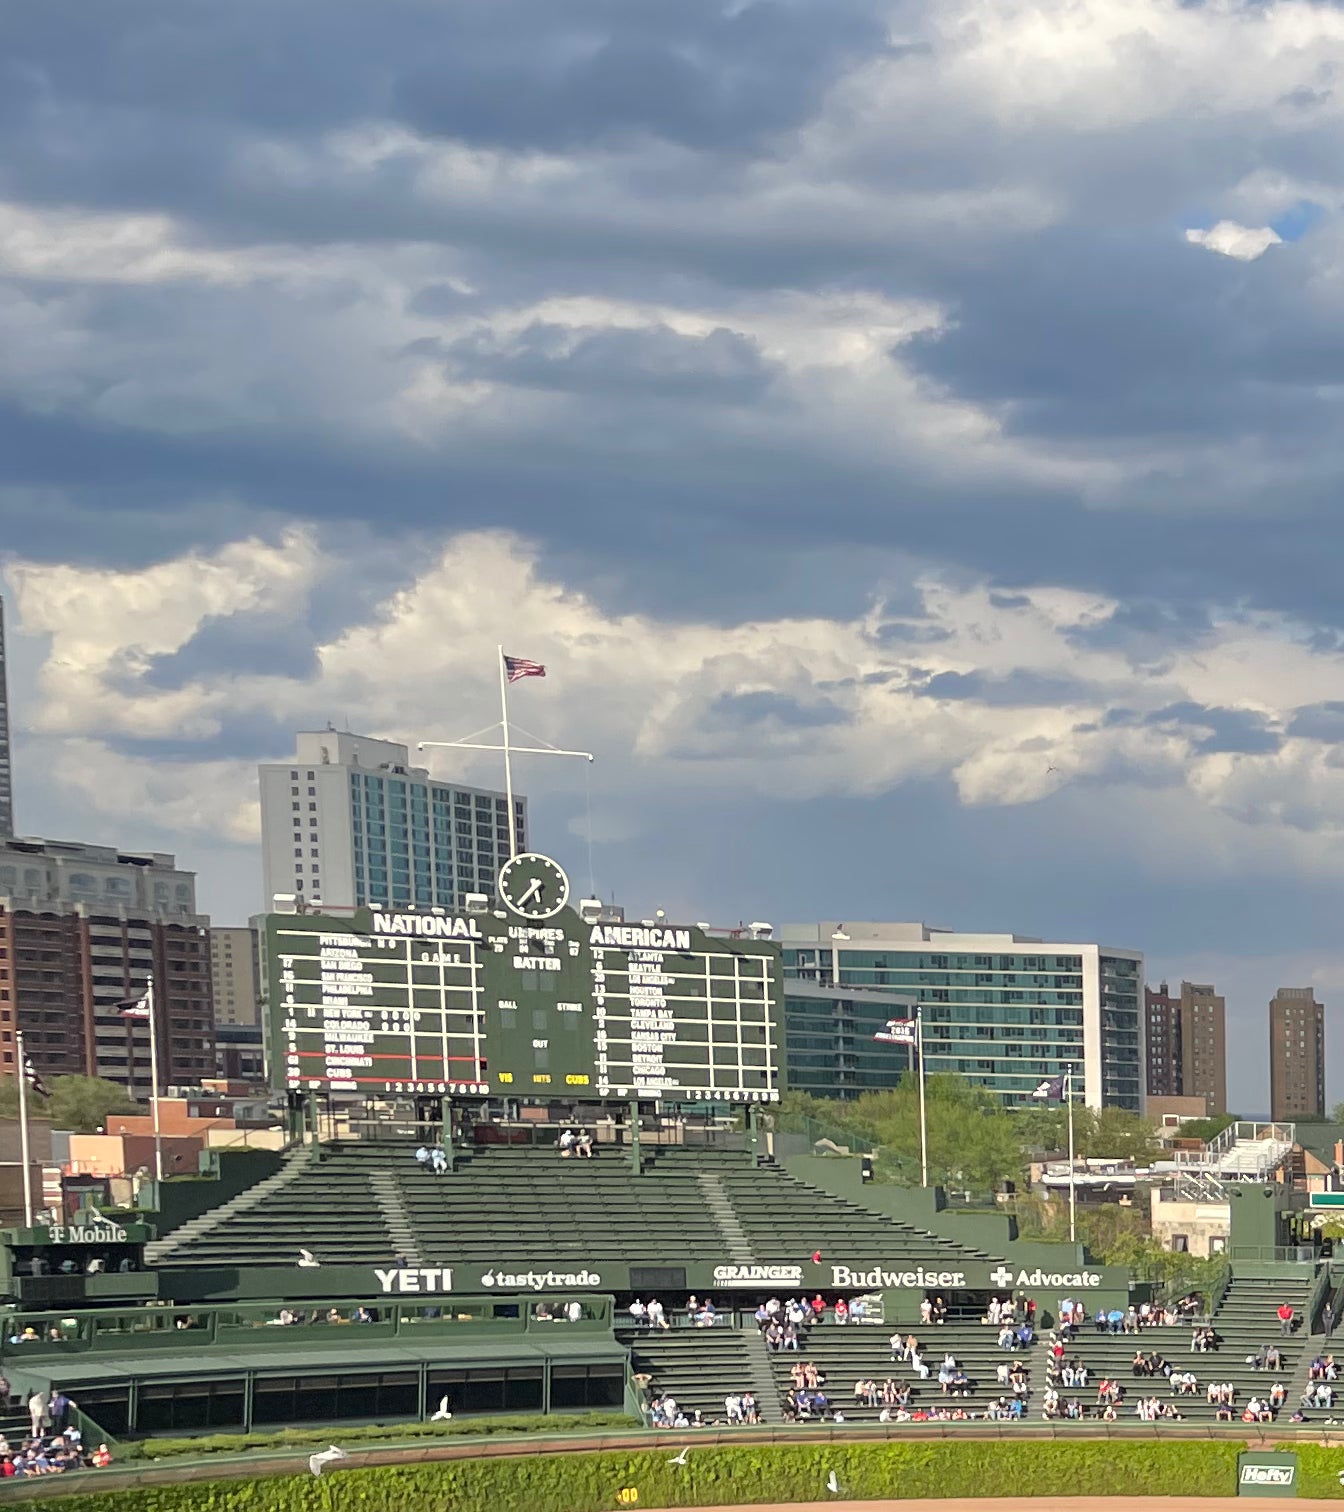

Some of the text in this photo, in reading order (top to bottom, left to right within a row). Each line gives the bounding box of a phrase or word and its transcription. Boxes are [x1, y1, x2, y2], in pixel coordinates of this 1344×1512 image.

[374, 913, 483, 937] NATIONAL
[589, 925, 690, 949] AMERICAN
[513, 956, 561, 971] BATTER
[326, 1068, 352, 1078] CUBS
[69, 1225, 127, 1243] Mobile
[374, 1268, 600, 1292] YETI tastytrade
[713, 1265, 803, 1280] GRAINGER
[1015, 1268, 1100, 1287] Advocate
[1244, 1467, 1291, 1483] Hefty
